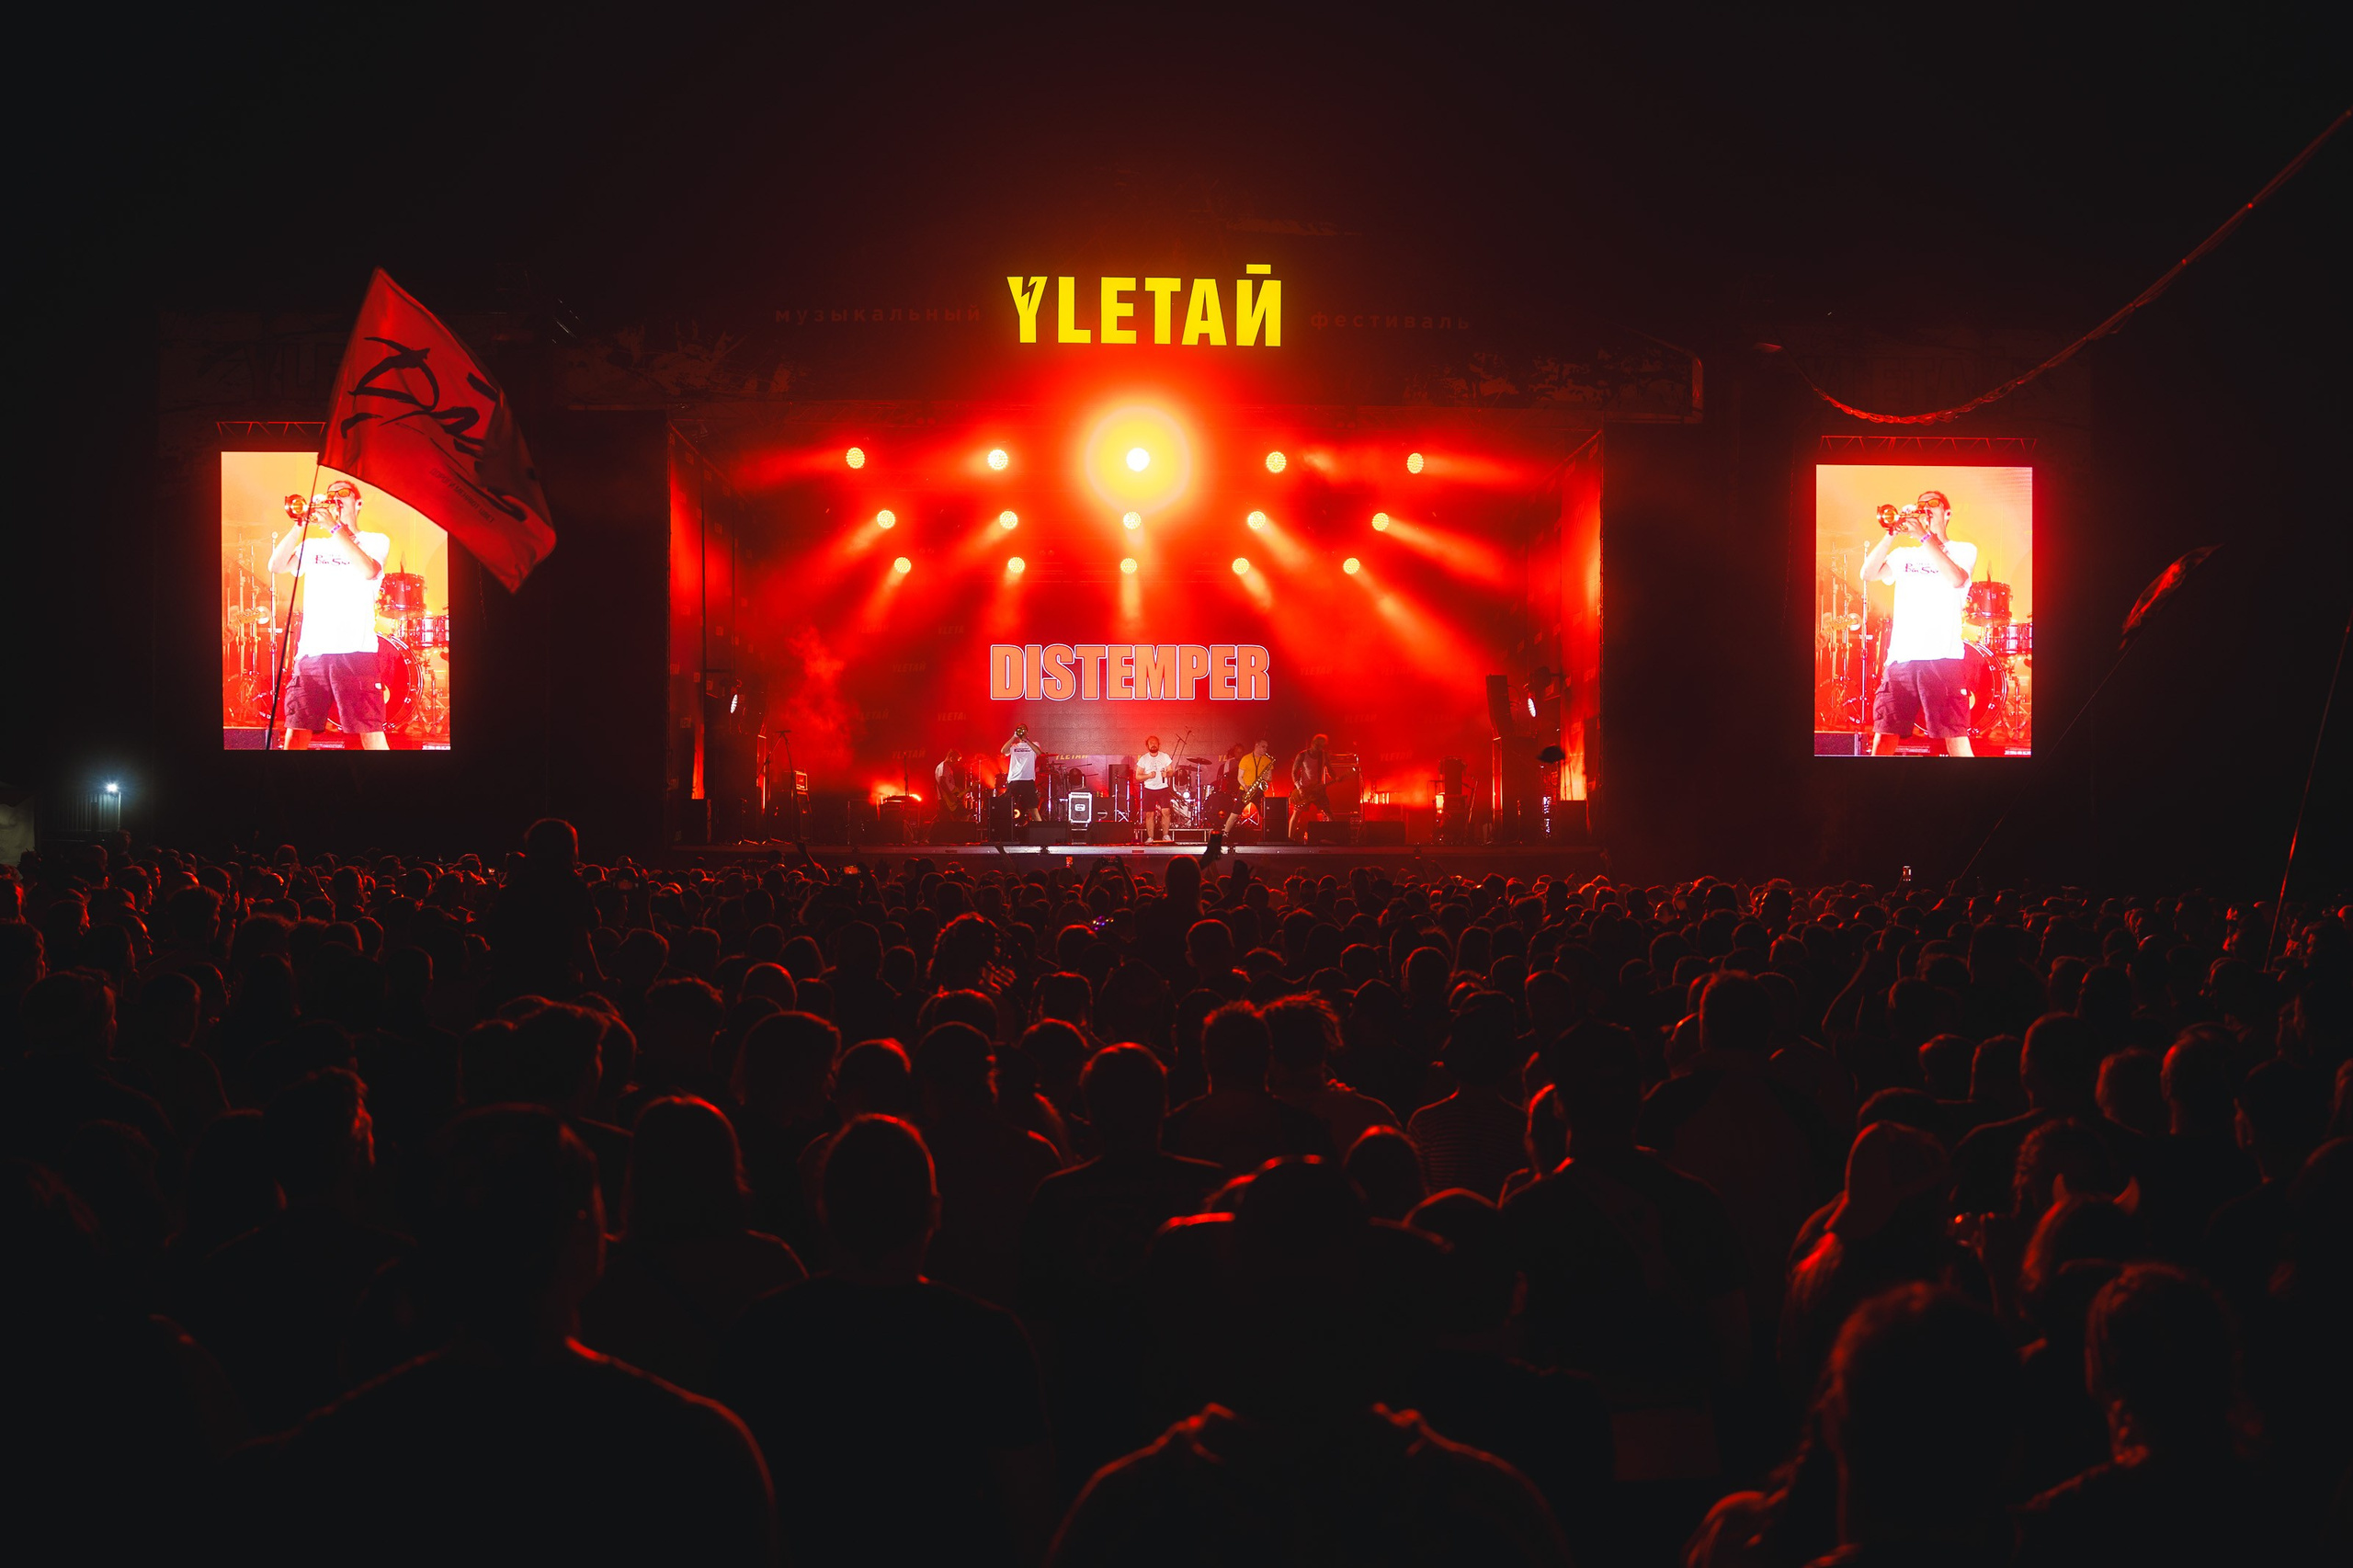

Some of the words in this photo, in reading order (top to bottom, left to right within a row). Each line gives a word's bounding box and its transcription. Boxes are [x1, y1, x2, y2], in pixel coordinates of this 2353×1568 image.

[775, 305, 981, 326] музыкальный
[1310, 311, 1471, 330] фестиваль
[990, 643, 1270, 701] DISTEMPER
